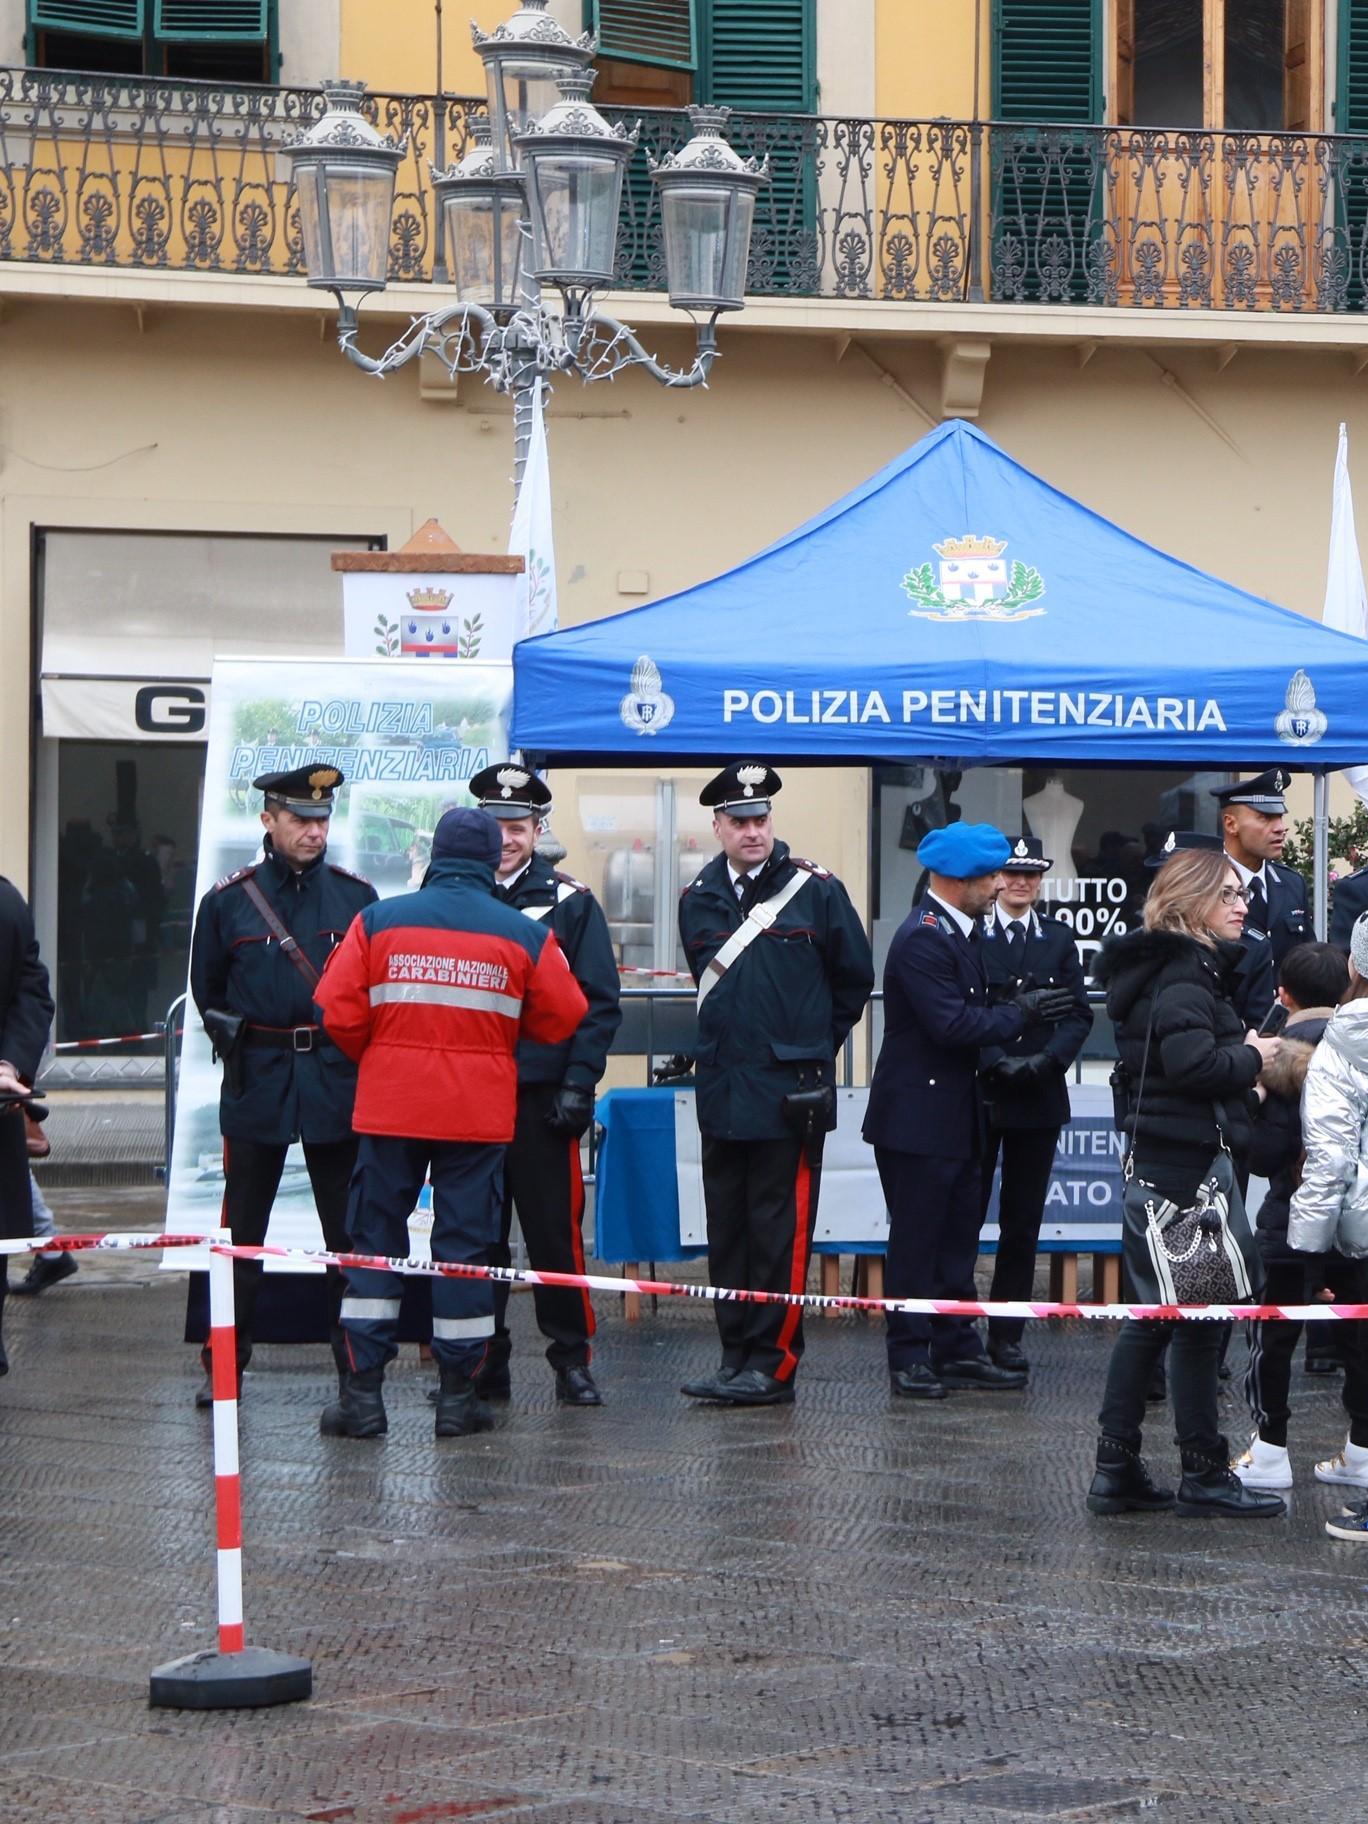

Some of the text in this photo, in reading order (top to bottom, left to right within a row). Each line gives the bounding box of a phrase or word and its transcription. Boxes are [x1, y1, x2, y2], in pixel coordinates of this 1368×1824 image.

[298, 700, 434, 734] POLIZIA
[723, 689, 1227, 733] POLIZIA PENITENZIARIA
[1041, 878, 1127, 903] TUTTO
[388, 954, 508, 979] ASSOCIAZIONE NAZIONALE
[388, 966, 507, 990] CARABINIERI
